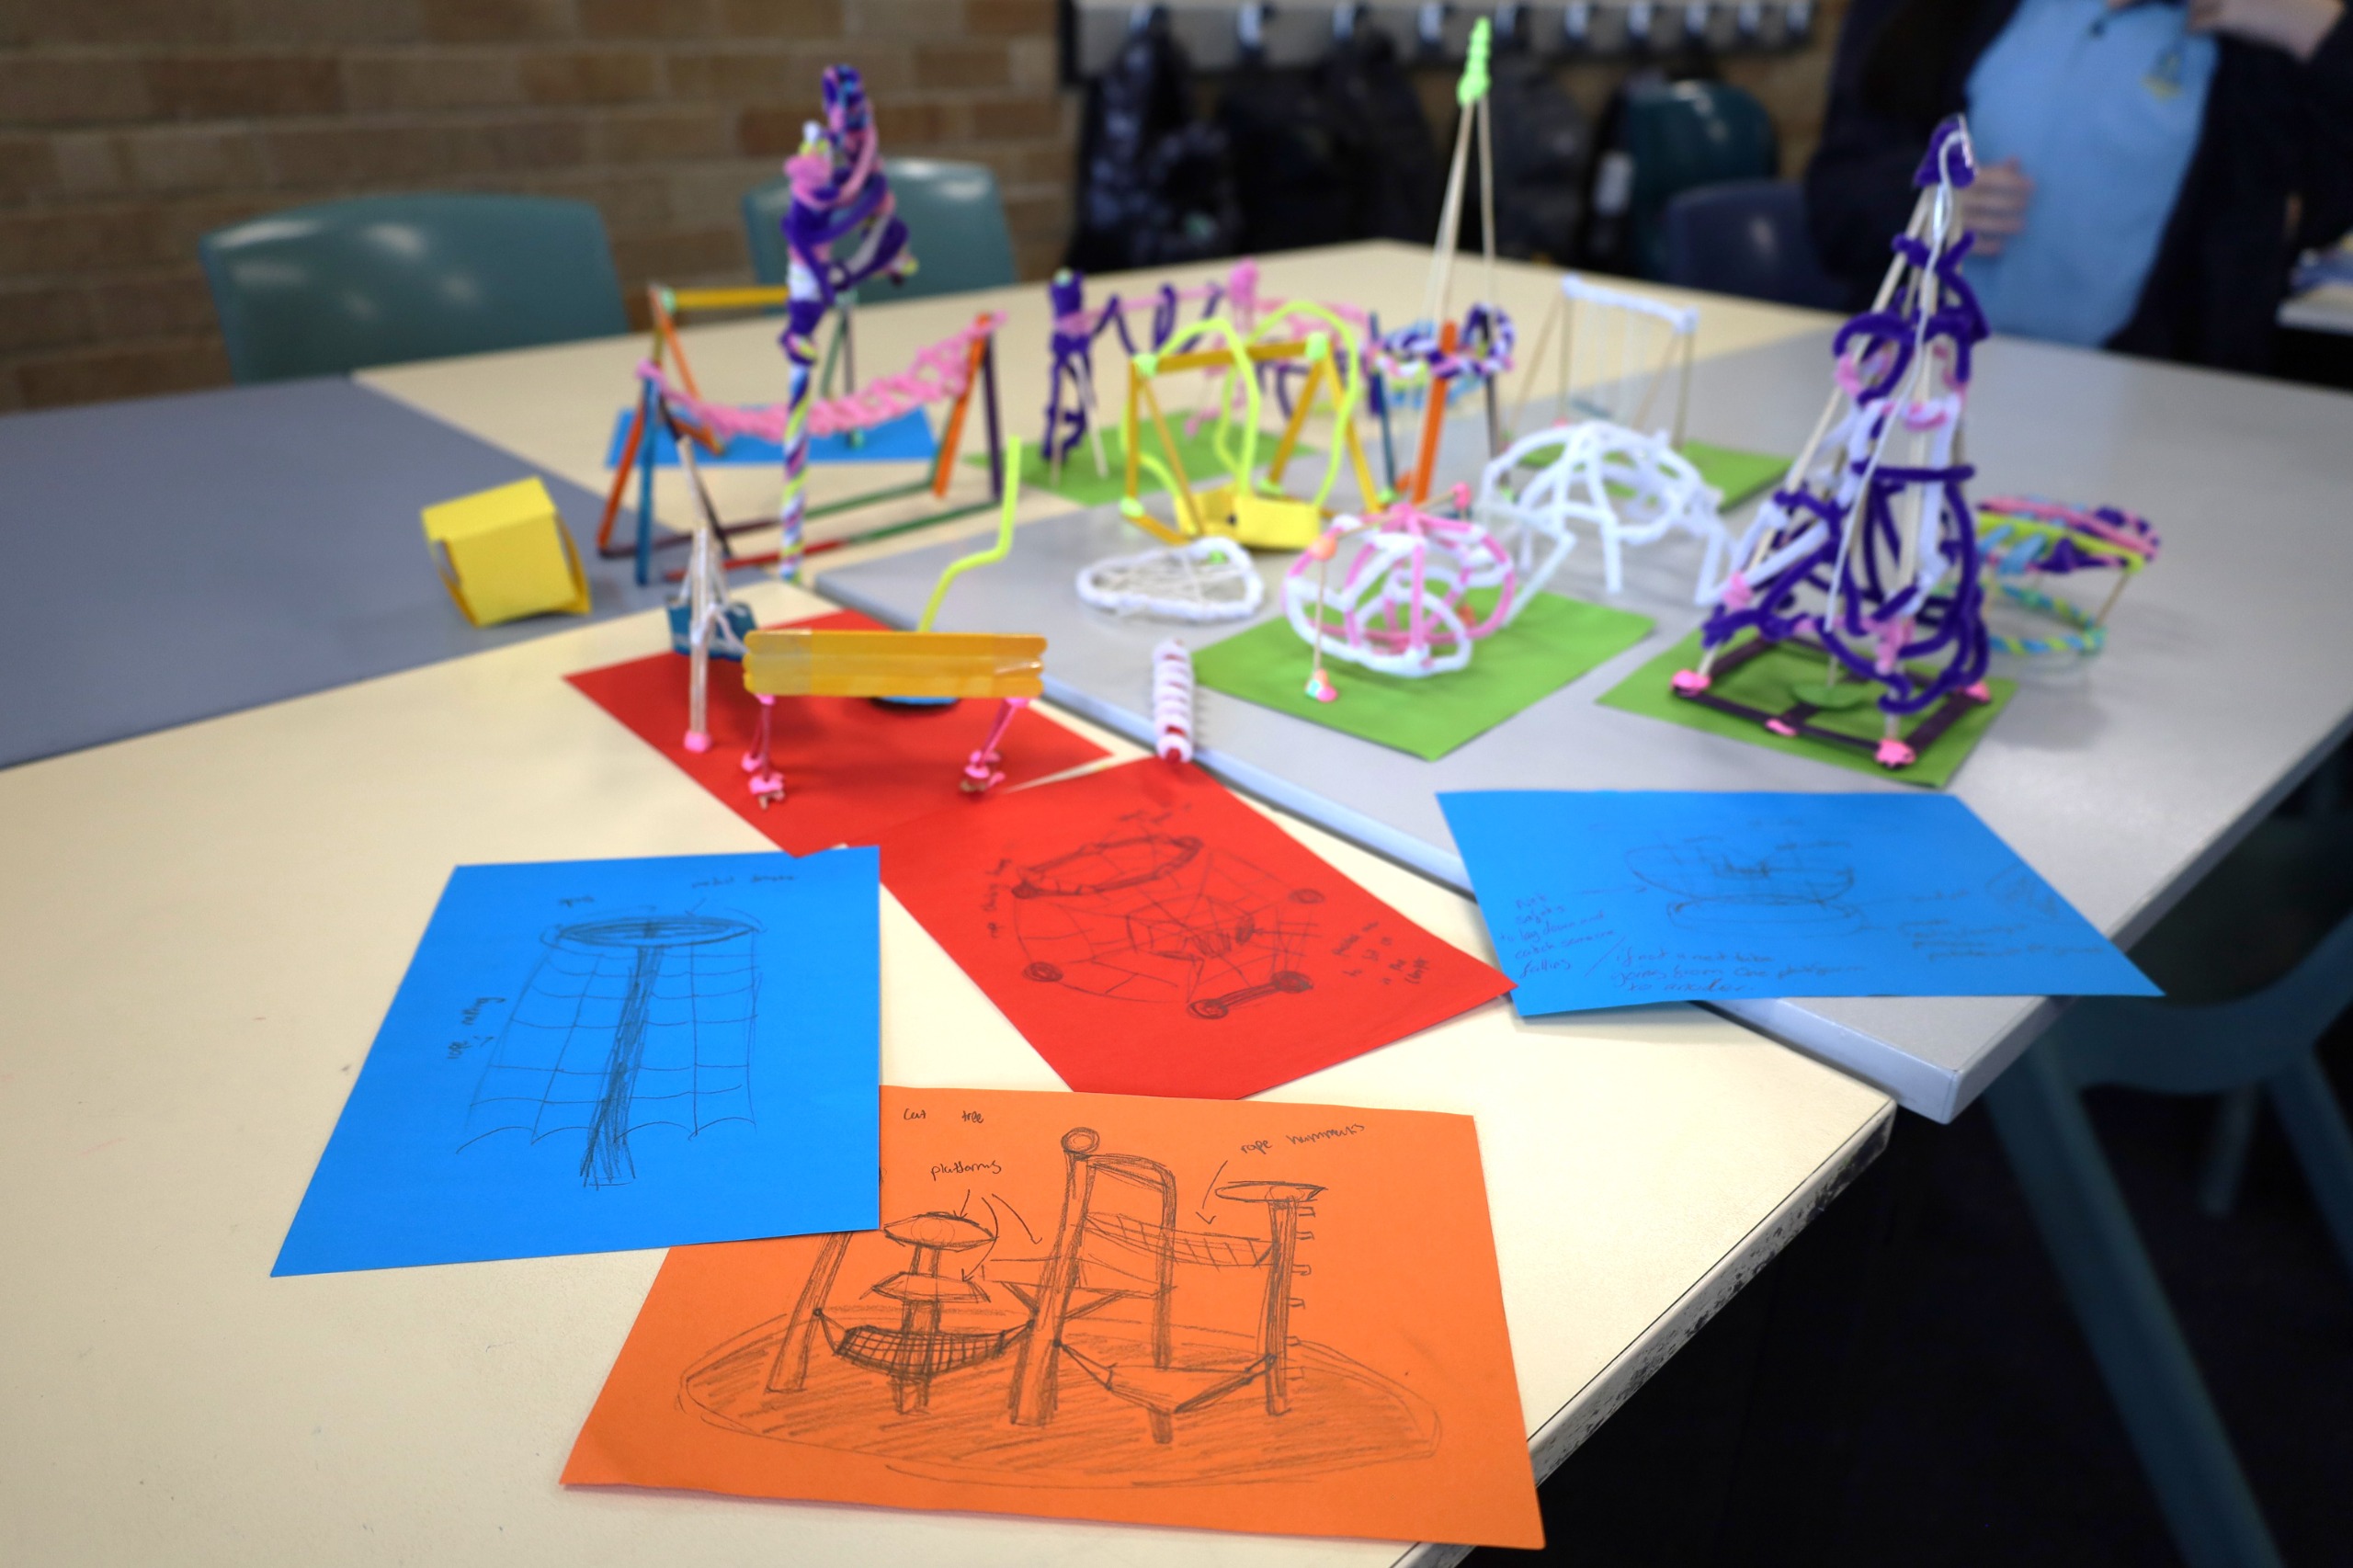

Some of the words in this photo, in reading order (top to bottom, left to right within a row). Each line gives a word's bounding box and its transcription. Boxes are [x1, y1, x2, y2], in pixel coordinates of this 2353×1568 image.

[961, 1109, 984, 1124] tree
[1240, 1139, 1273, 1155] rope
[930, 1159, 1003, 1182] platforms
